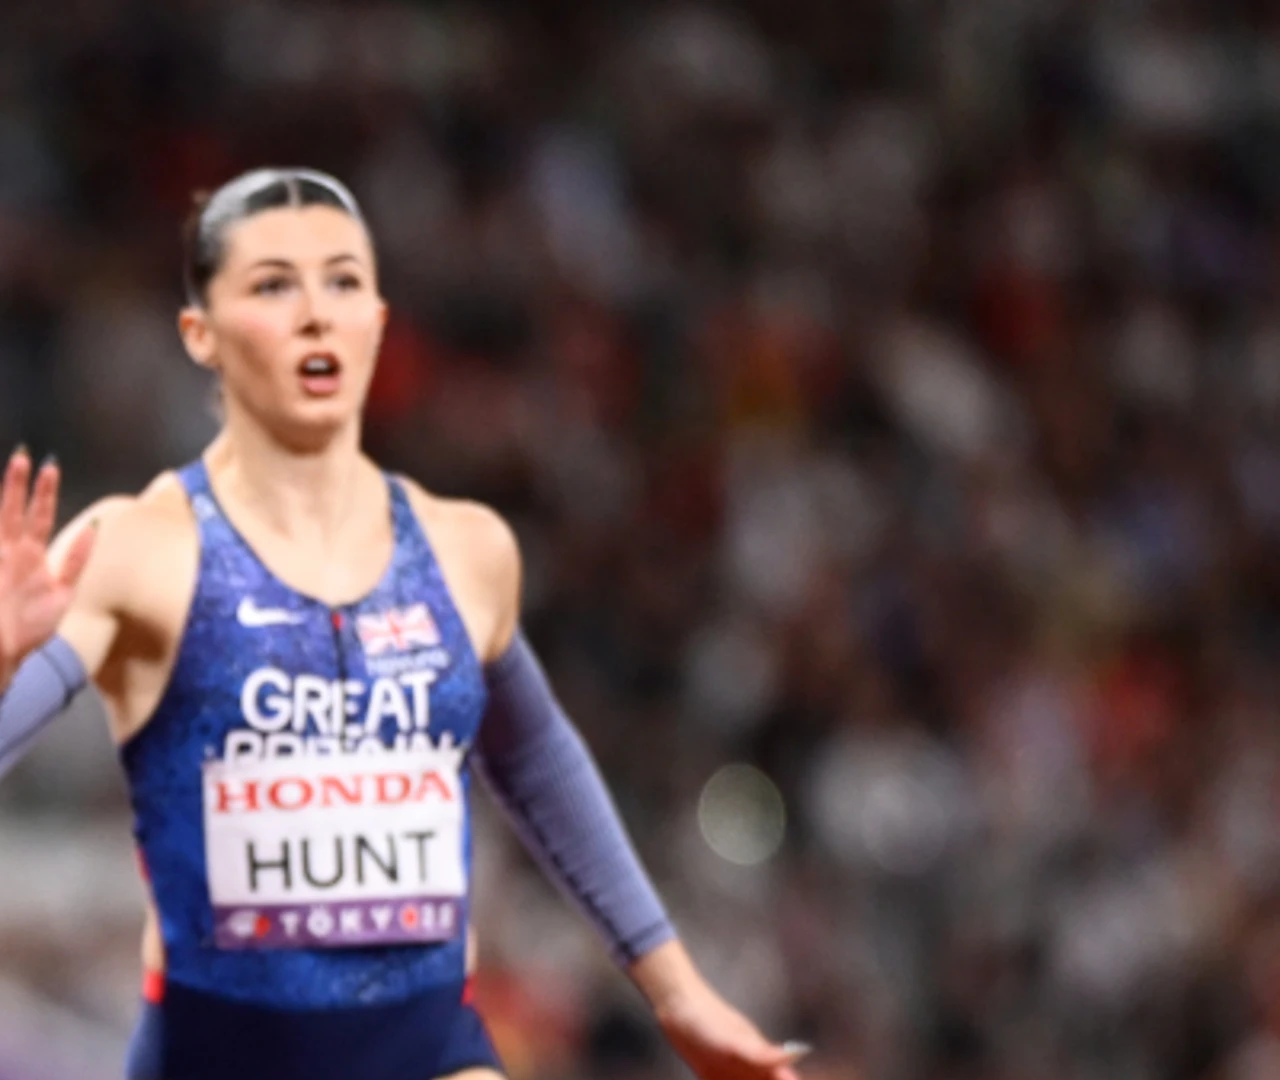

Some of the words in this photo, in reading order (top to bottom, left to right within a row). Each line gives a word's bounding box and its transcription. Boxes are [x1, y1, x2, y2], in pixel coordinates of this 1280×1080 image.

[241, 667, 438, 738] GREAT
[212, 770, 455, 814] HONDA
[245, 829, 438, 892] HUNT
